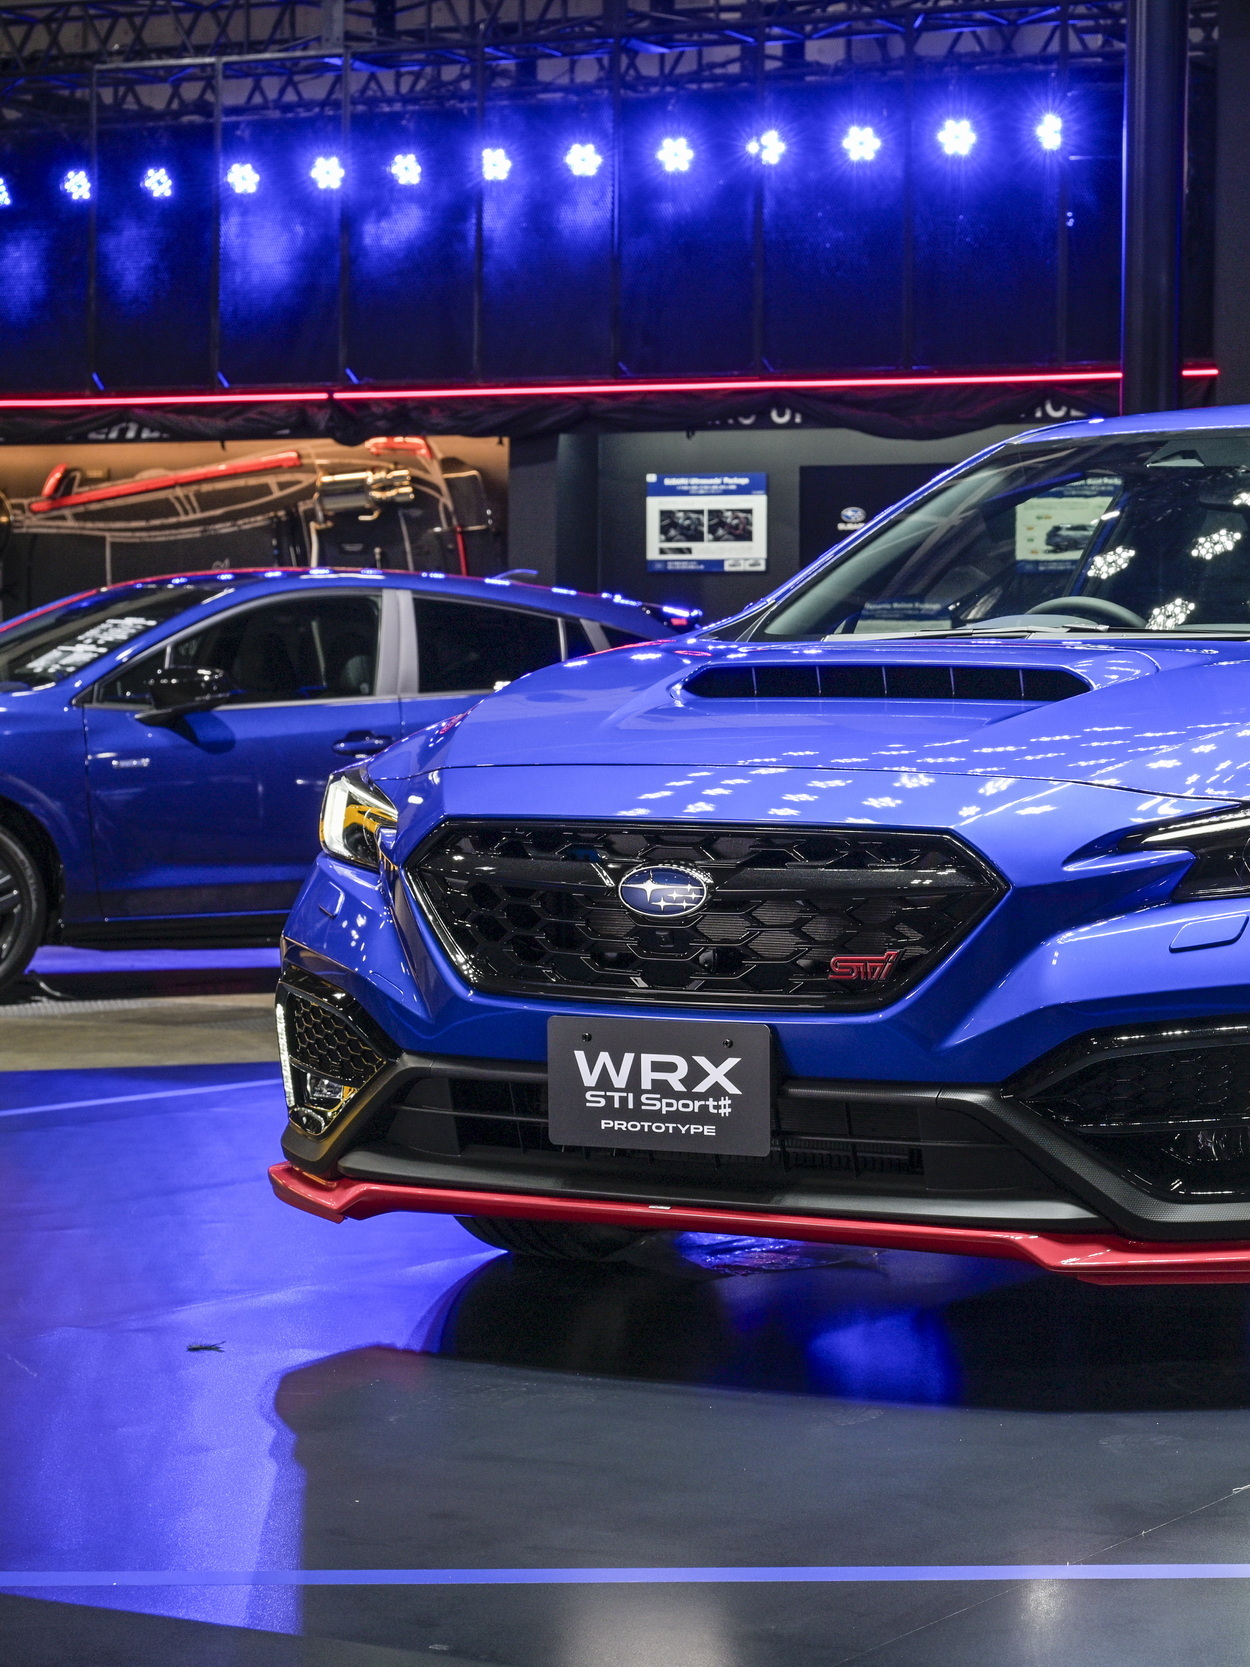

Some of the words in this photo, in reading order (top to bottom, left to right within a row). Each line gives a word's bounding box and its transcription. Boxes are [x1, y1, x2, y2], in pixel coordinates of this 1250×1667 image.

[573, 1050, 743, 1095] WRX
[585, 1090, 634, 1109] STI
[600, 1119, 716, 1136] PROTOTYPE
